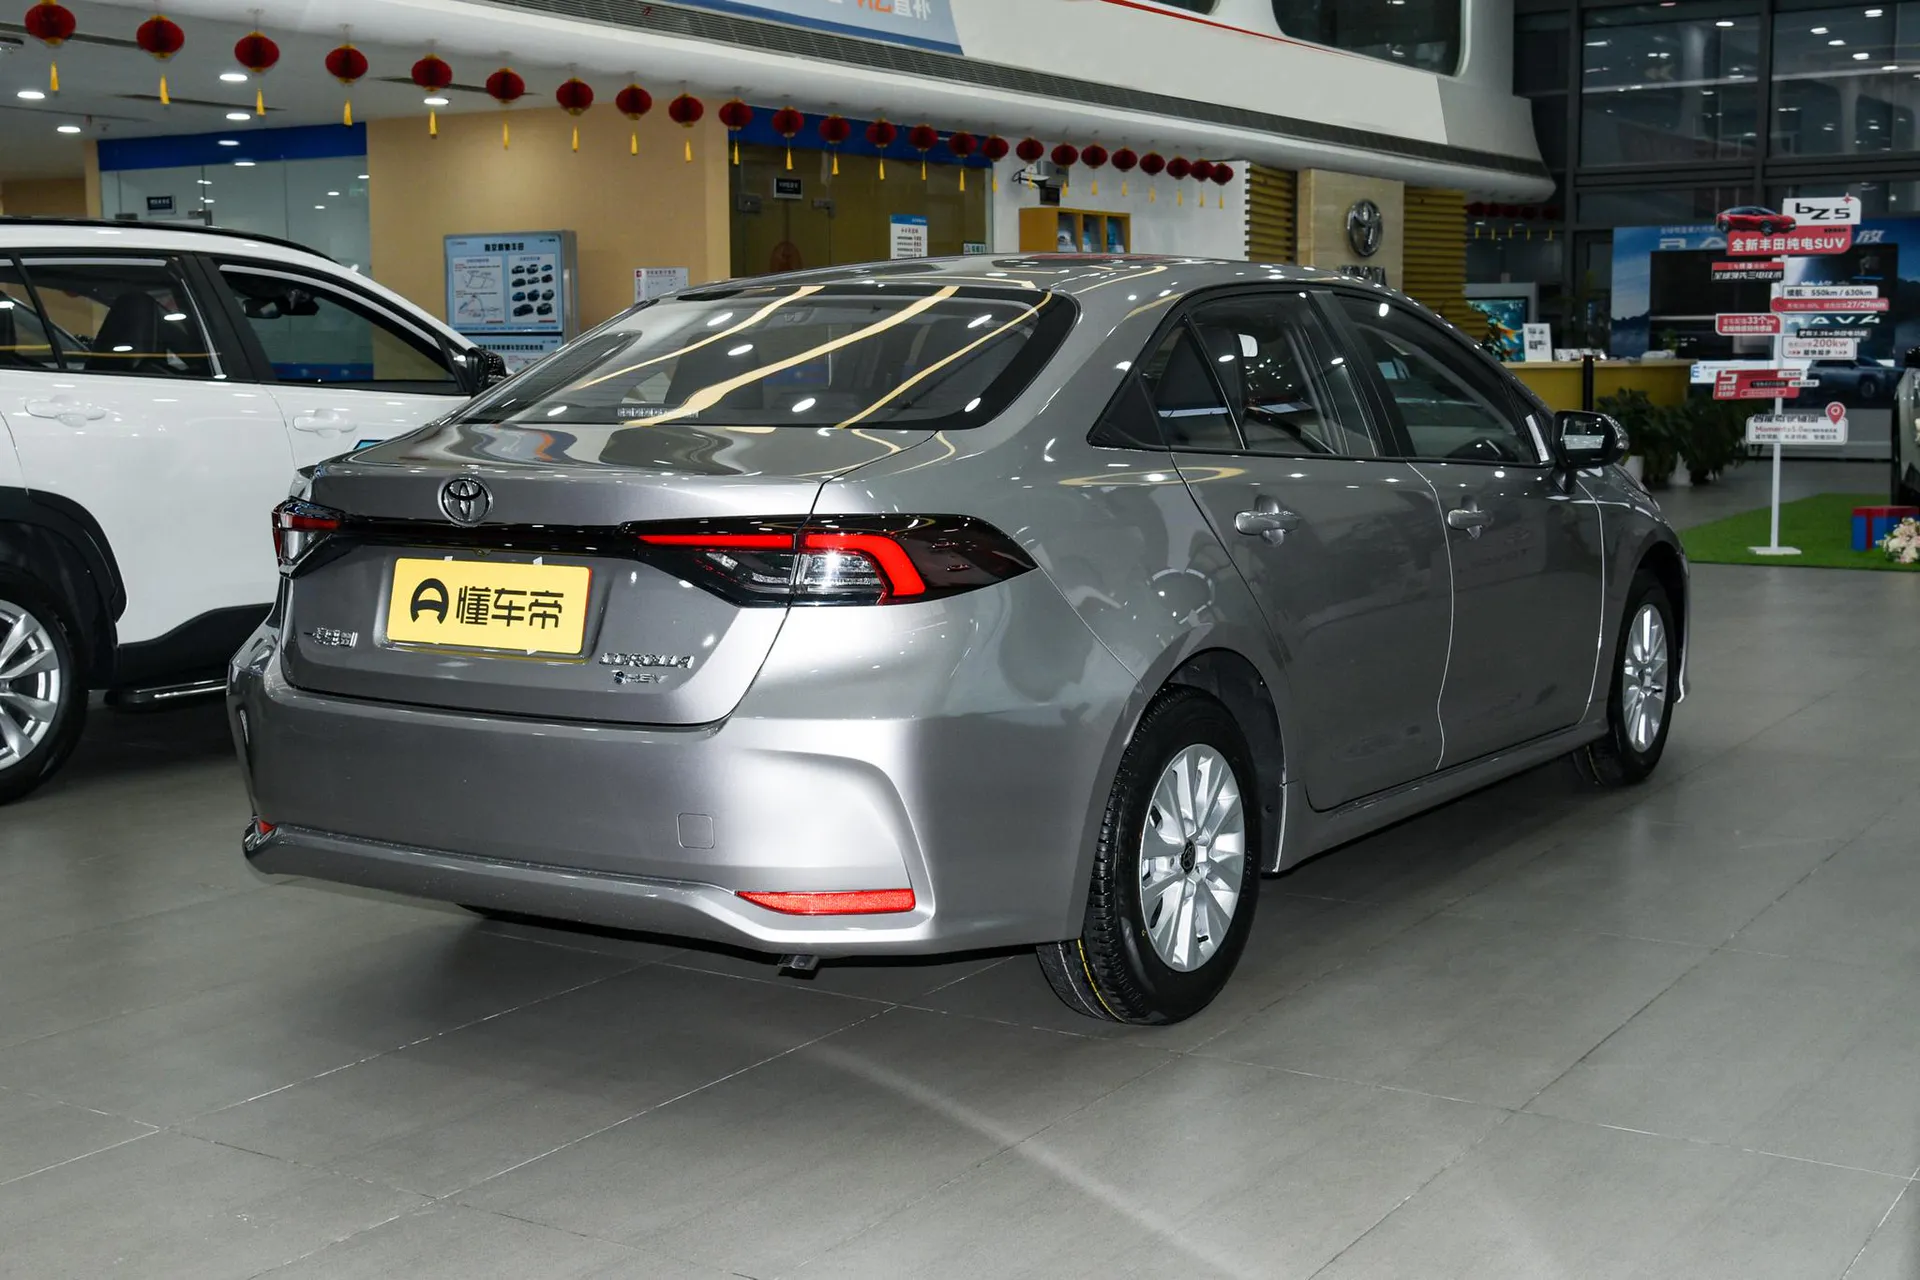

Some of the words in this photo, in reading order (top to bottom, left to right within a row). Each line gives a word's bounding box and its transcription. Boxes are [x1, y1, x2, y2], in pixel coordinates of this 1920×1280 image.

[1732, 238, 1845, 251] 全新丰田纯电SUV
[456, 585, 564, 630] 懂车帝
[599, 653, 695, 669] COROLLA
